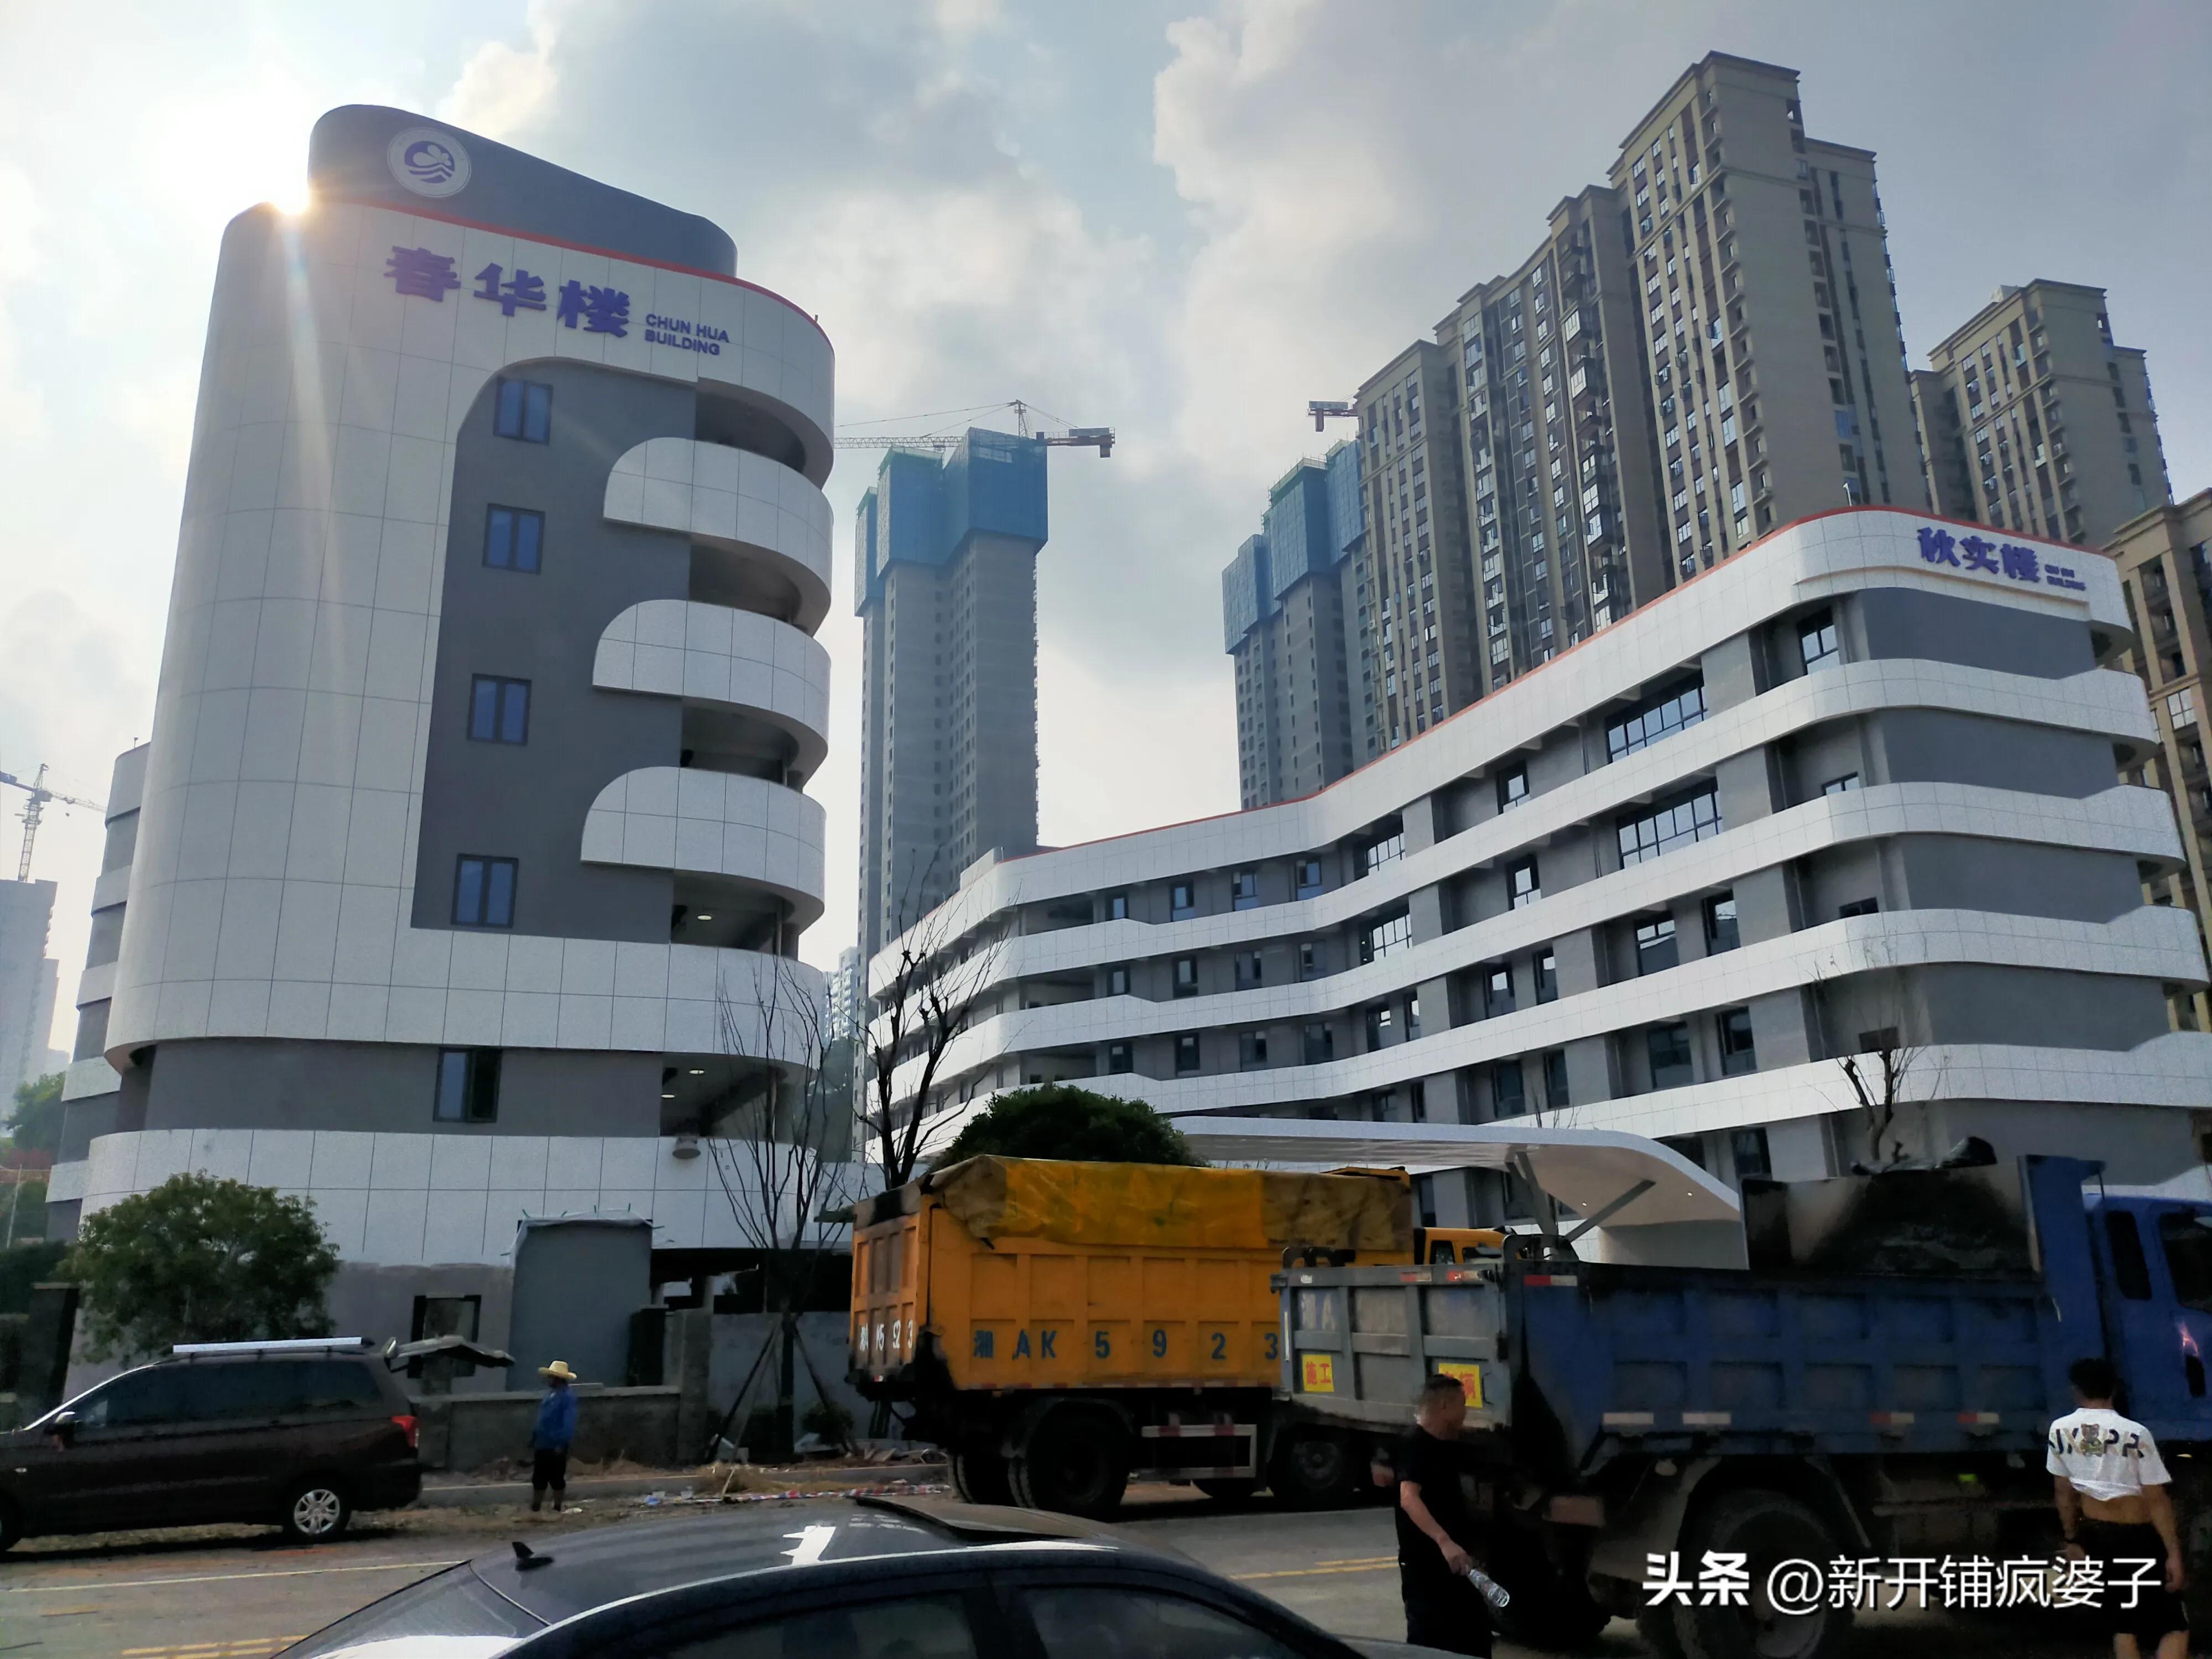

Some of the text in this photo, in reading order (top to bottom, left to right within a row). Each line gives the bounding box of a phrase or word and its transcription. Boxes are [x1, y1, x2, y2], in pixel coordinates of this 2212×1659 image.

[383, 245, 630, 338] 春华楼
[644, 328, 721, 356] BUILDING
[645, 313, 729, 343] CHUN HUA
